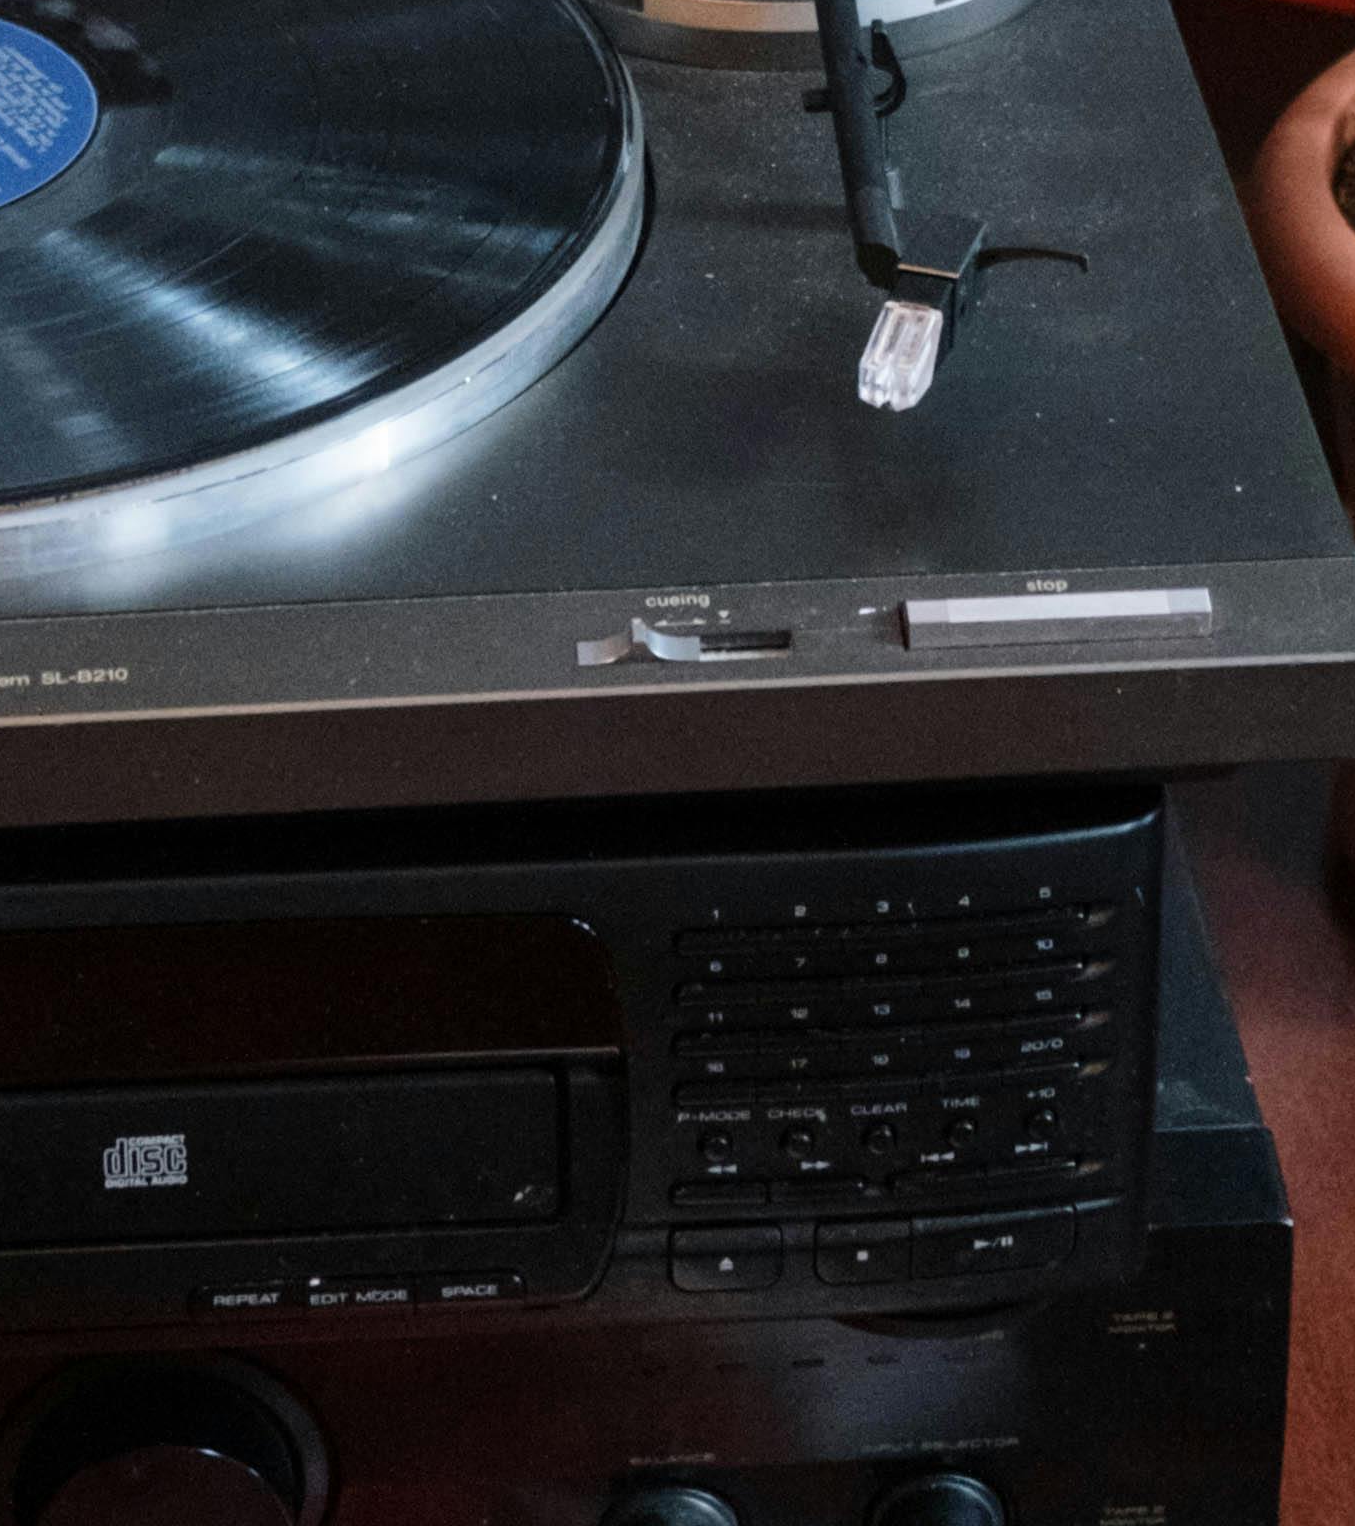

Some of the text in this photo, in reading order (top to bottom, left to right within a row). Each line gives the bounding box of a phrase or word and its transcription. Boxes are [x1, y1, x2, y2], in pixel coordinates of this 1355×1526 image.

[1026, 578, 1069, 595] stop
[645, 592, 711, 611] cueing
[41, 667, 129, 687] SL-B210
[1019, 1037, 1065, 1053] 20/0
[676, 1087, 1057, 1123] P-MODE CHECK CLEAR TIME +10
[127, 1133, 186, 1147] COMPACT
[102, 1136, 189, 1178] disc
[103, 1174, 189, 1190] DIGITAL AUDIO
[212, 1283, 500, 1308] REPEAT EDIT MODE SPACE
